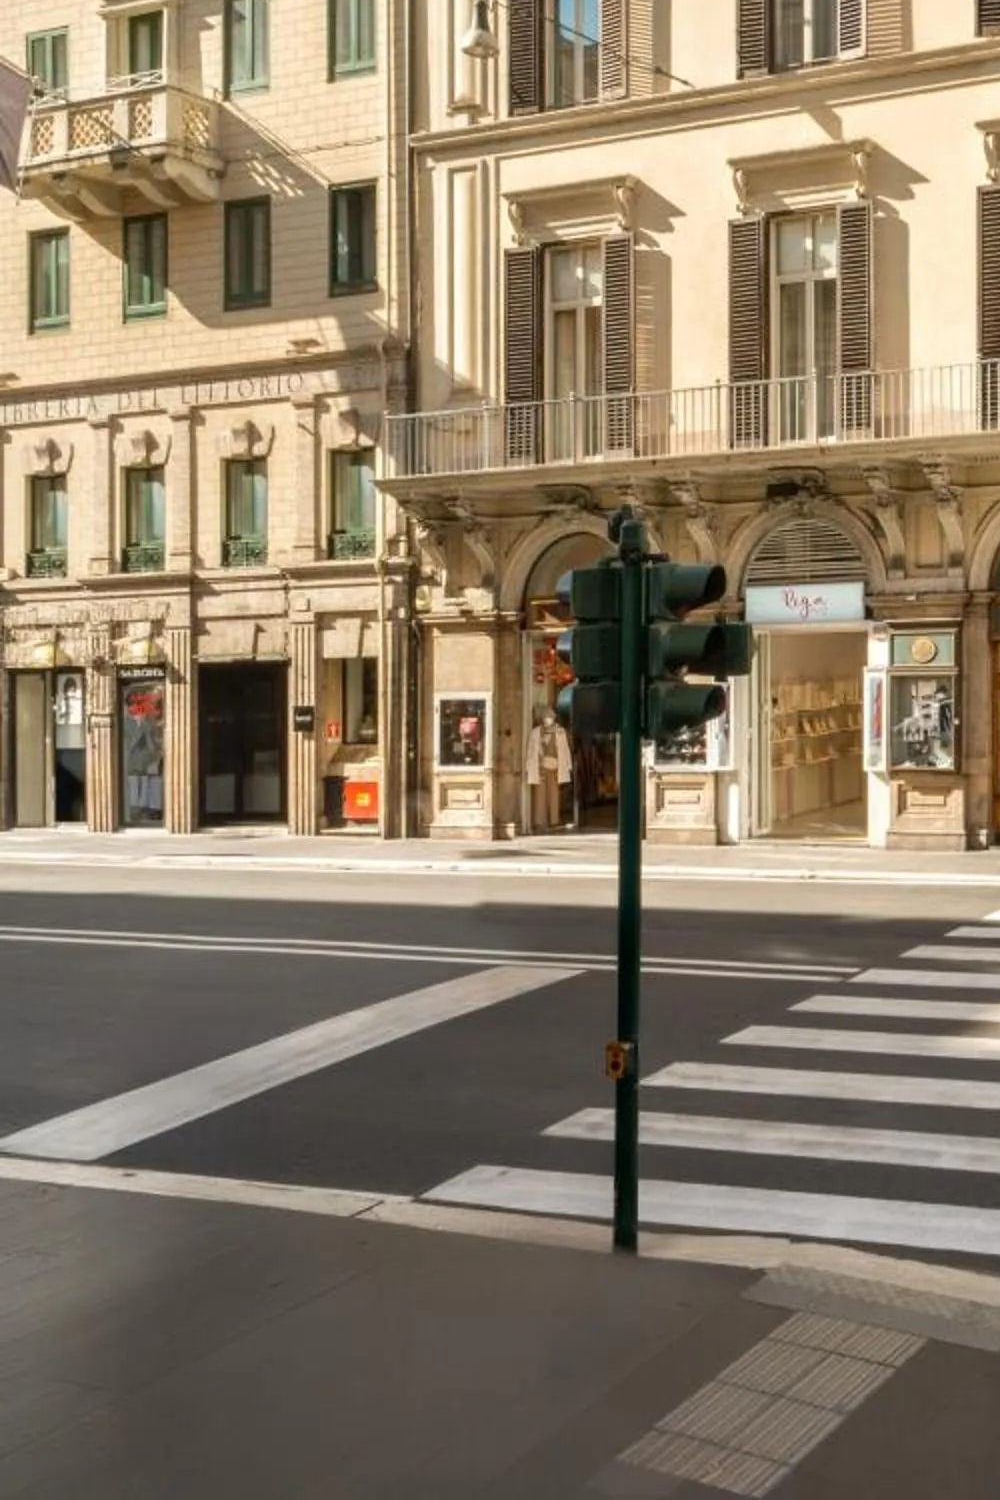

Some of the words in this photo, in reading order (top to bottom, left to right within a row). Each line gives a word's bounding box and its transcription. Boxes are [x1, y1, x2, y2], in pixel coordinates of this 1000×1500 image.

[2, 396, 99, 423] IBRERIA
[117, 387, 161, 411] DEL
[181, 372, 304, 405] LITTORIO
